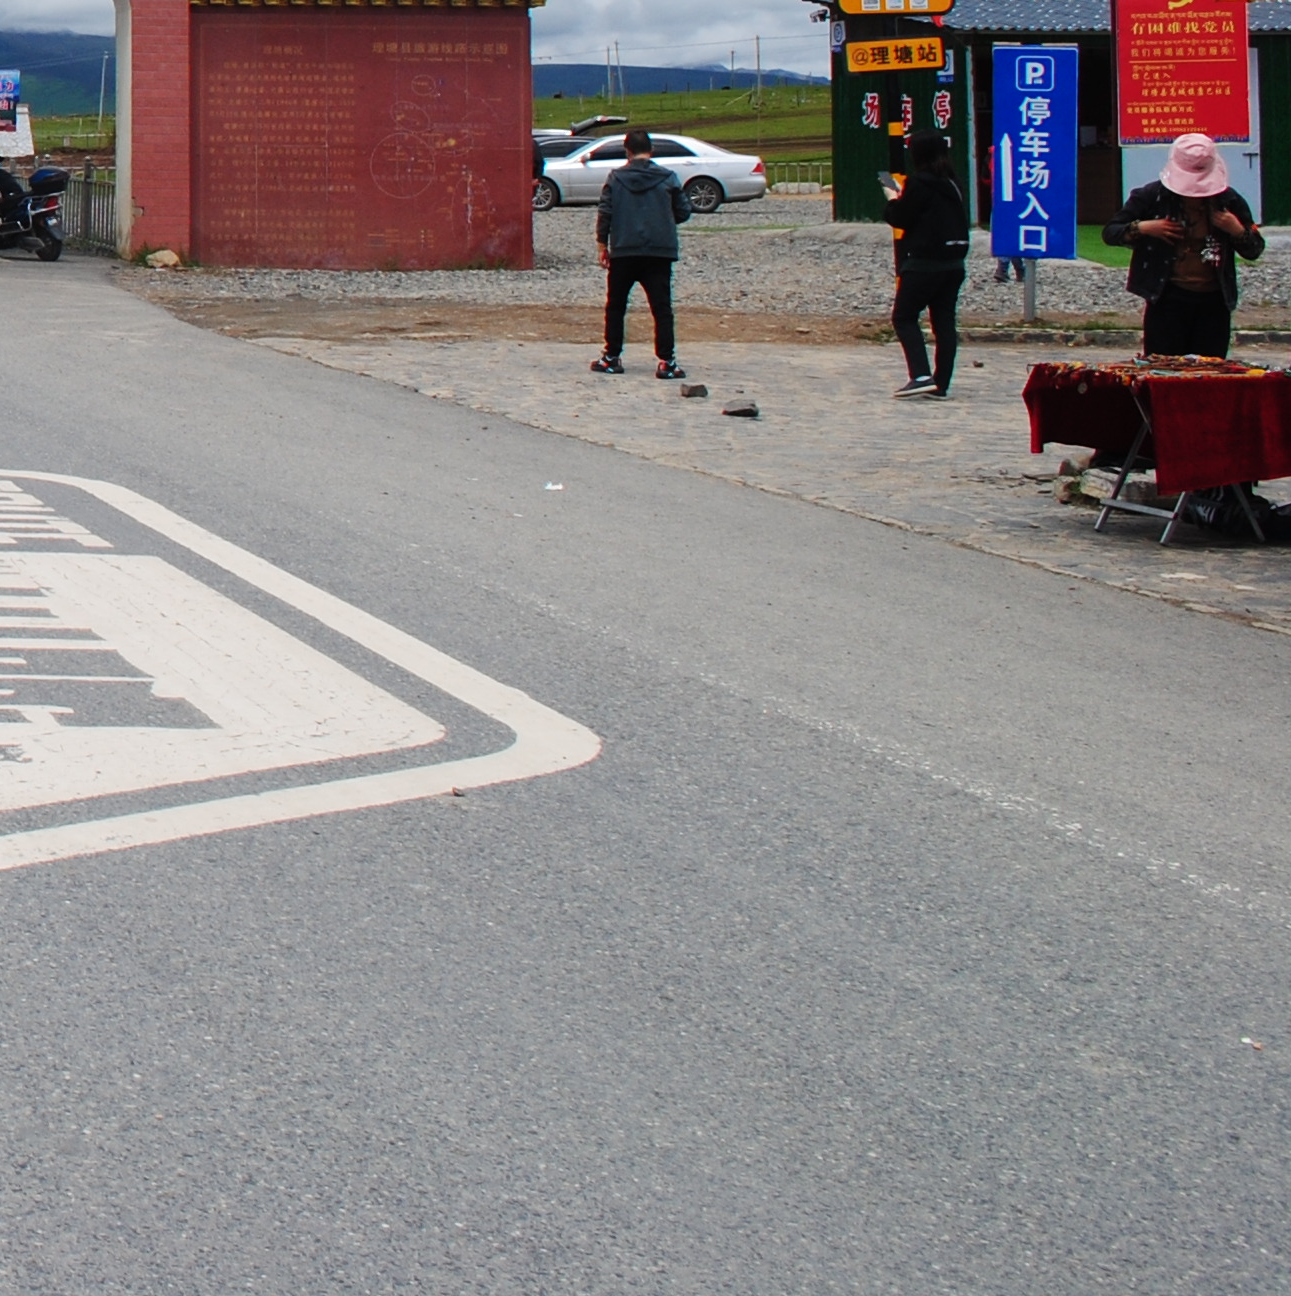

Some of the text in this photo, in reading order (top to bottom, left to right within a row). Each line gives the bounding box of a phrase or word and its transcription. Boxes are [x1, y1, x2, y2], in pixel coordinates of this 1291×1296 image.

[1131, 21, 1235, 35] 有困难找党员
[852, 44, 938, 66] @理塘站
[1018, 95, 1052, 253] 停车场入口
